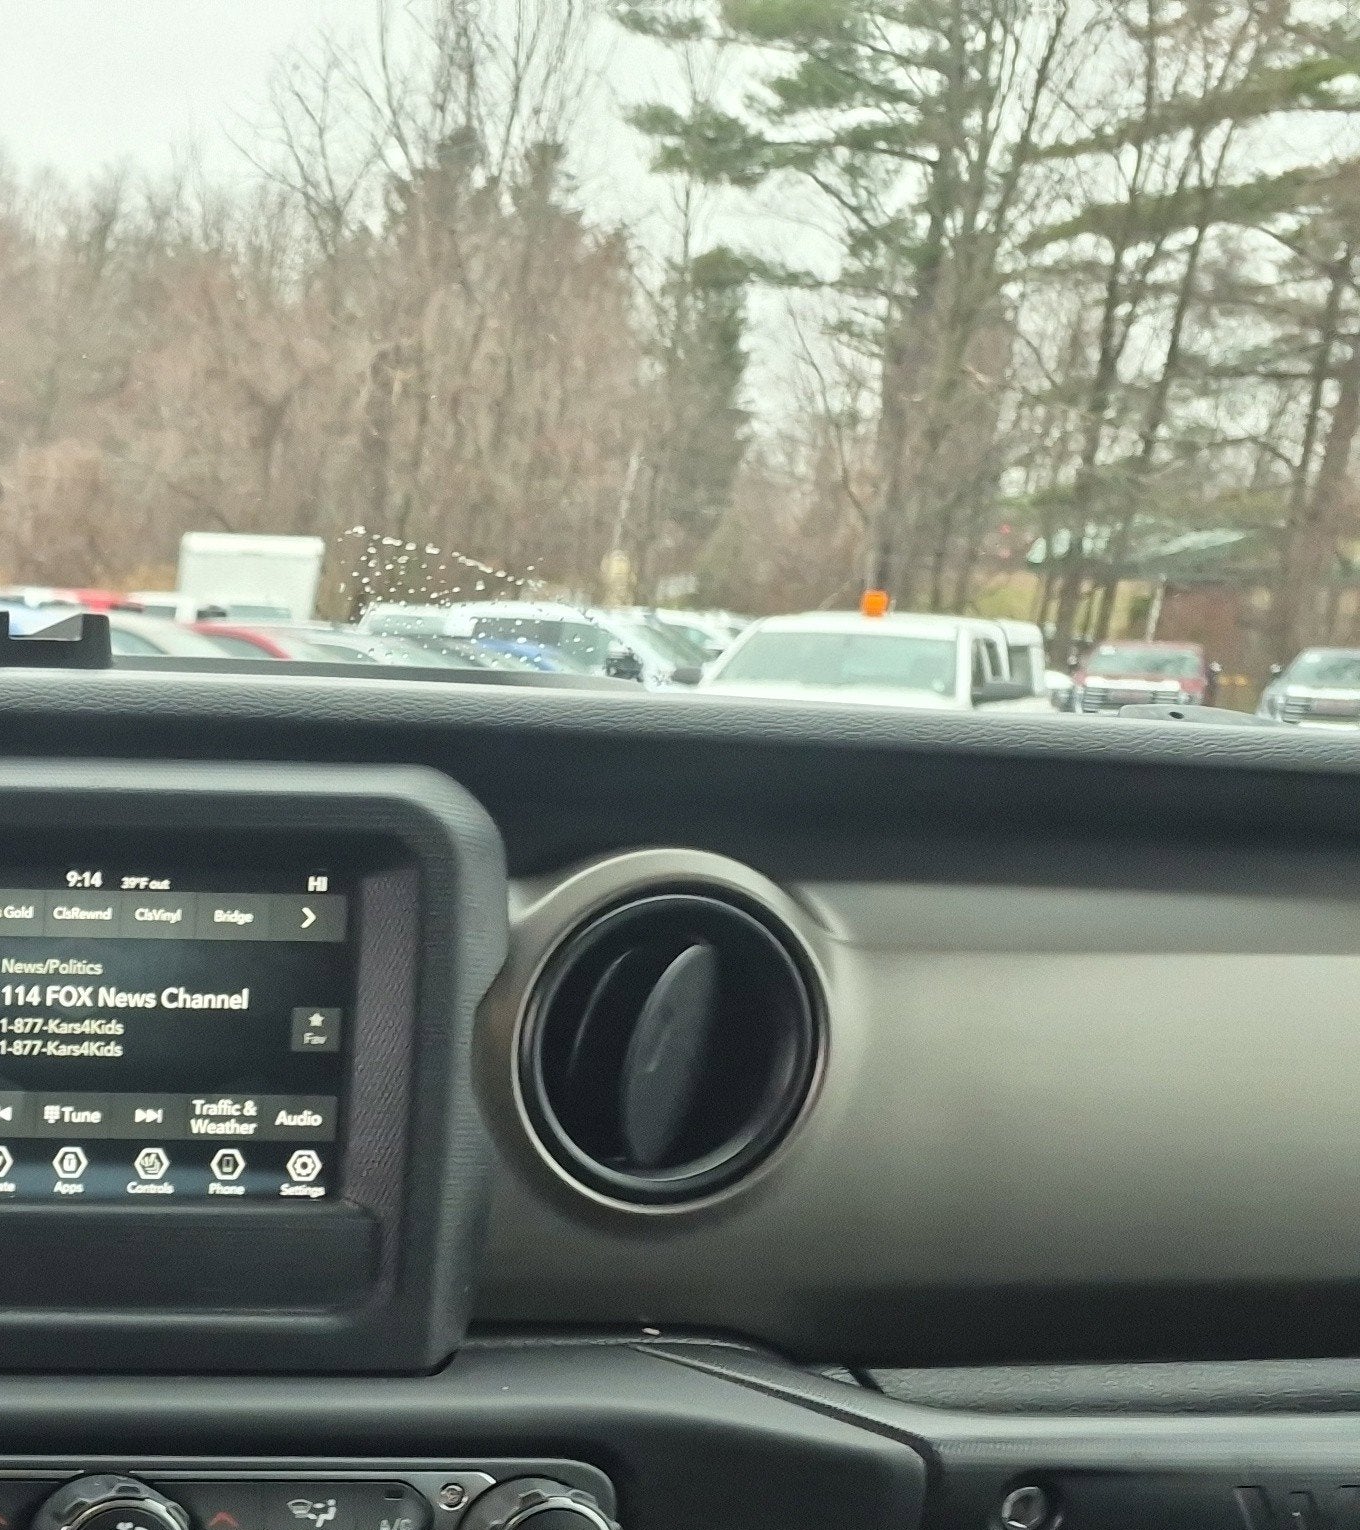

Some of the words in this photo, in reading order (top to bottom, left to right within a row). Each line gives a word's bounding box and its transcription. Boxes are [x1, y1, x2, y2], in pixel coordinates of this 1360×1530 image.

[66, 870, 103, 888] 9:14
[3, 905, 34, 919] Gold
[134, 908, 182, 924] ClsVinyl
[213, 909, 254, 925] Bridge
[1, 958, 104, 976] News/Politics
[1, 984, 41, 1006] 114
[45, 984, 93, 1008] FOX
[97, 986, 157, 1009] News
[161, 987, 250, 1010] Channel
[61, 1106, 102, 1123] Tune
[191, 1099, 242, 1116] Traffic
[243, 1101, 258, 1116] &
[190, 1118, 258, 1135] Weather
[275, 1110, 323, 1127] Audio
[54, 1181, 84, 1194] Apps
[127, 1182, 175, 1195] Controls
[208, 1182, 246, 1195] Phone
[280, 1183, 326, 1199] Settings
